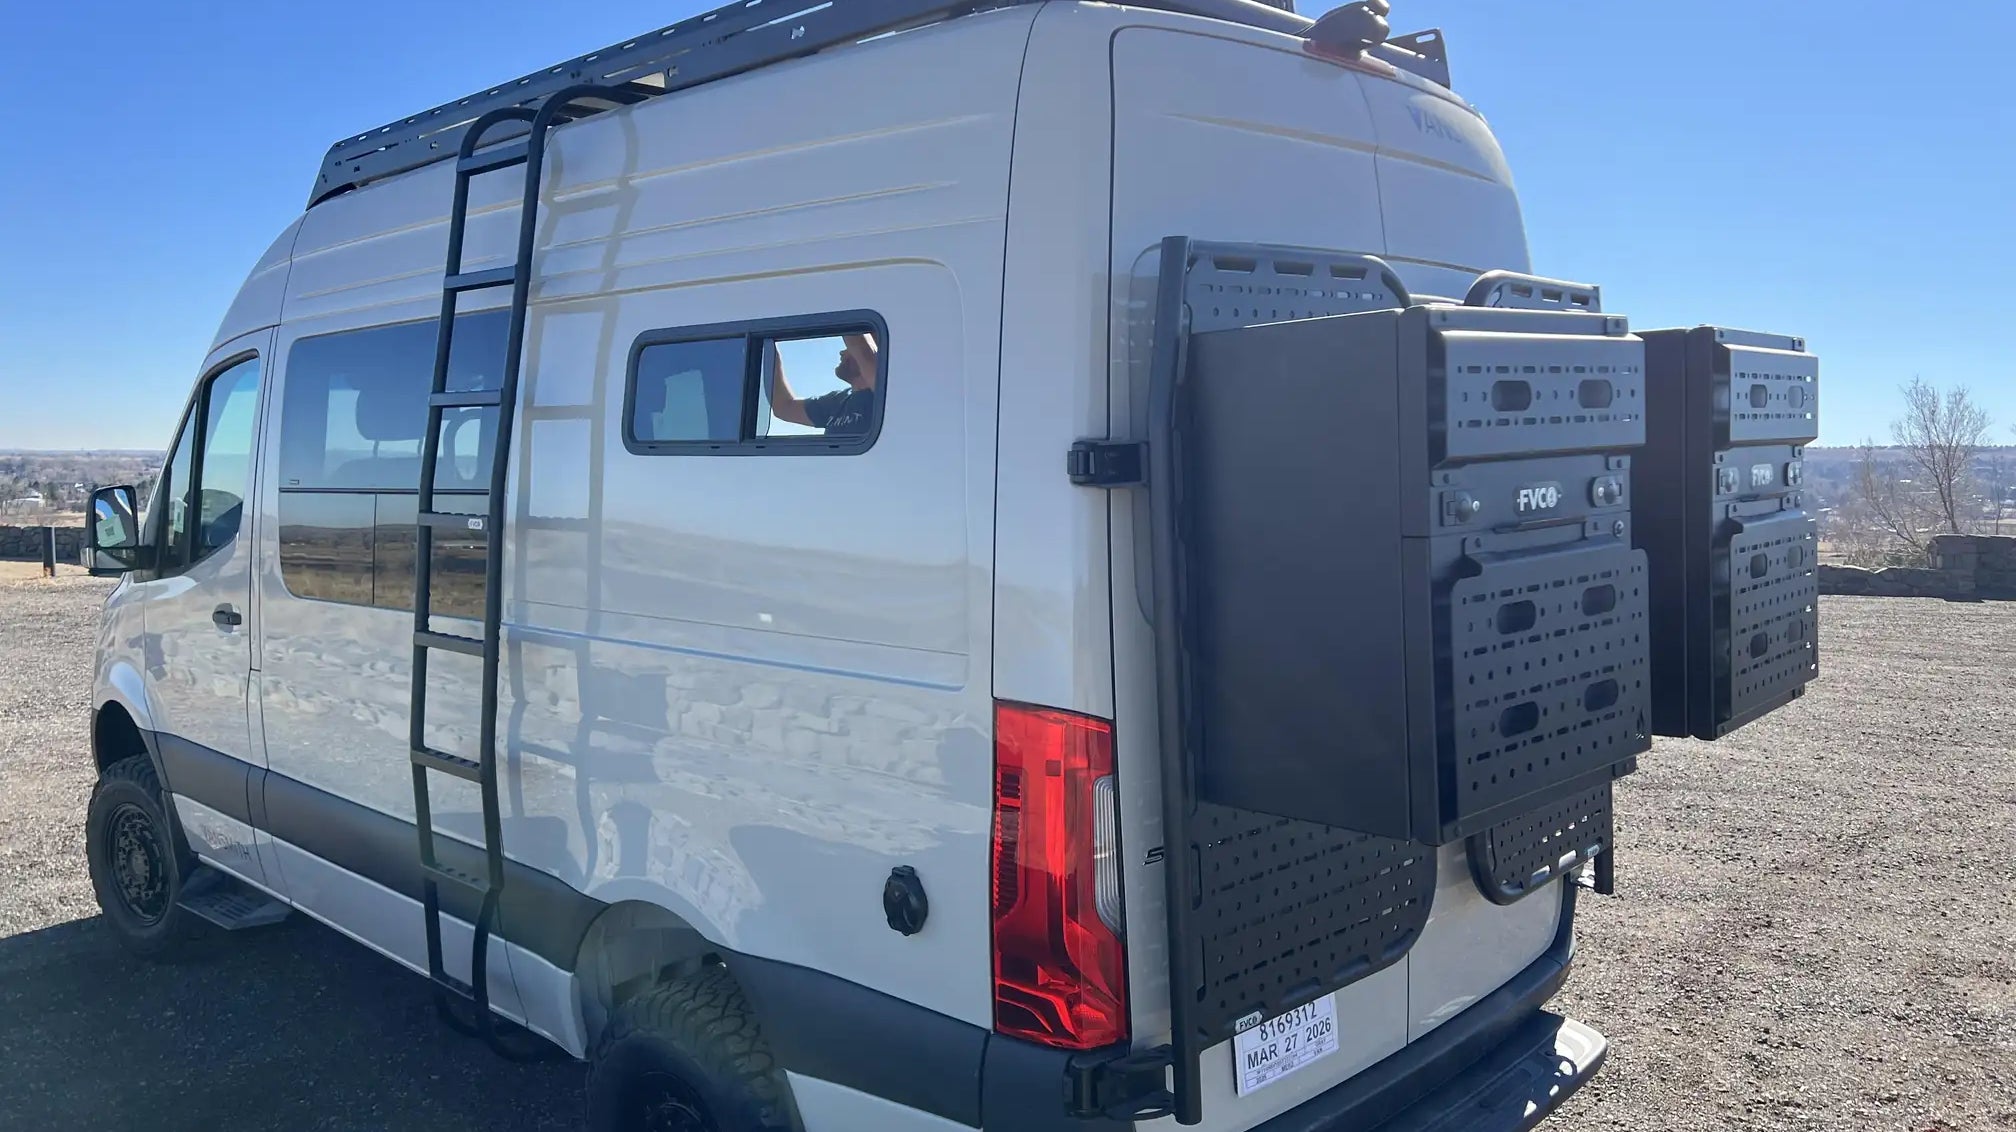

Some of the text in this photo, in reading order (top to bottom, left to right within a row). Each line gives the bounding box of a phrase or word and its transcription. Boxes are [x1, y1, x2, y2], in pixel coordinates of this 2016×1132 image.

[1519, 486, 1558, 512] FVCO
[1259, 1001, 1317, 1042] 8169312
[1247, 1043, 1278, 1070] MAR
[1284, 1033, 1298, 1053] 27
[1306, 1017, 1331, 1043] 2026
